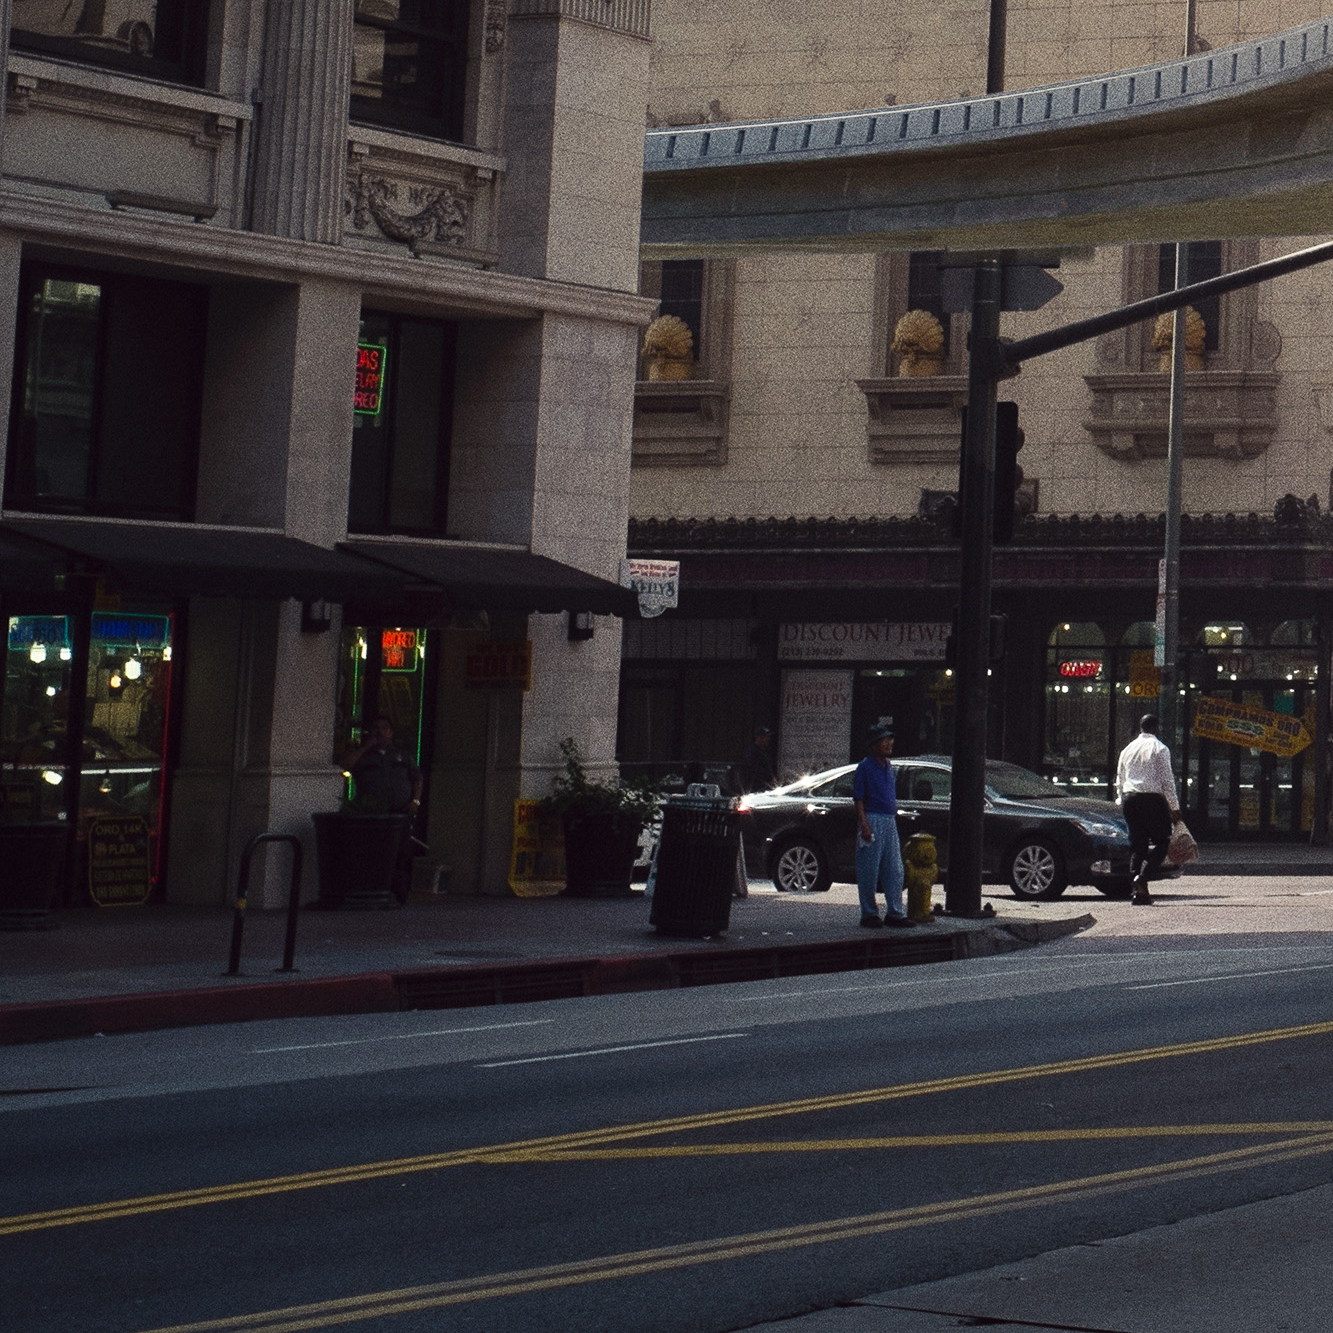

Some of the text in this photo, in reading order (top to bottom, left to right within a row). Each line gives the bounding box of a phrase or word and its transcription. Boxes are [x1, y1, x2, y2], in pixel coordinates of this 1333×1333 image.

[784, 624, 894, 642] DISCOUNT
[786, 694, 850, 708] JEWELRY
[1198, 699, 1302, 737] COMPRAMOS ORO
